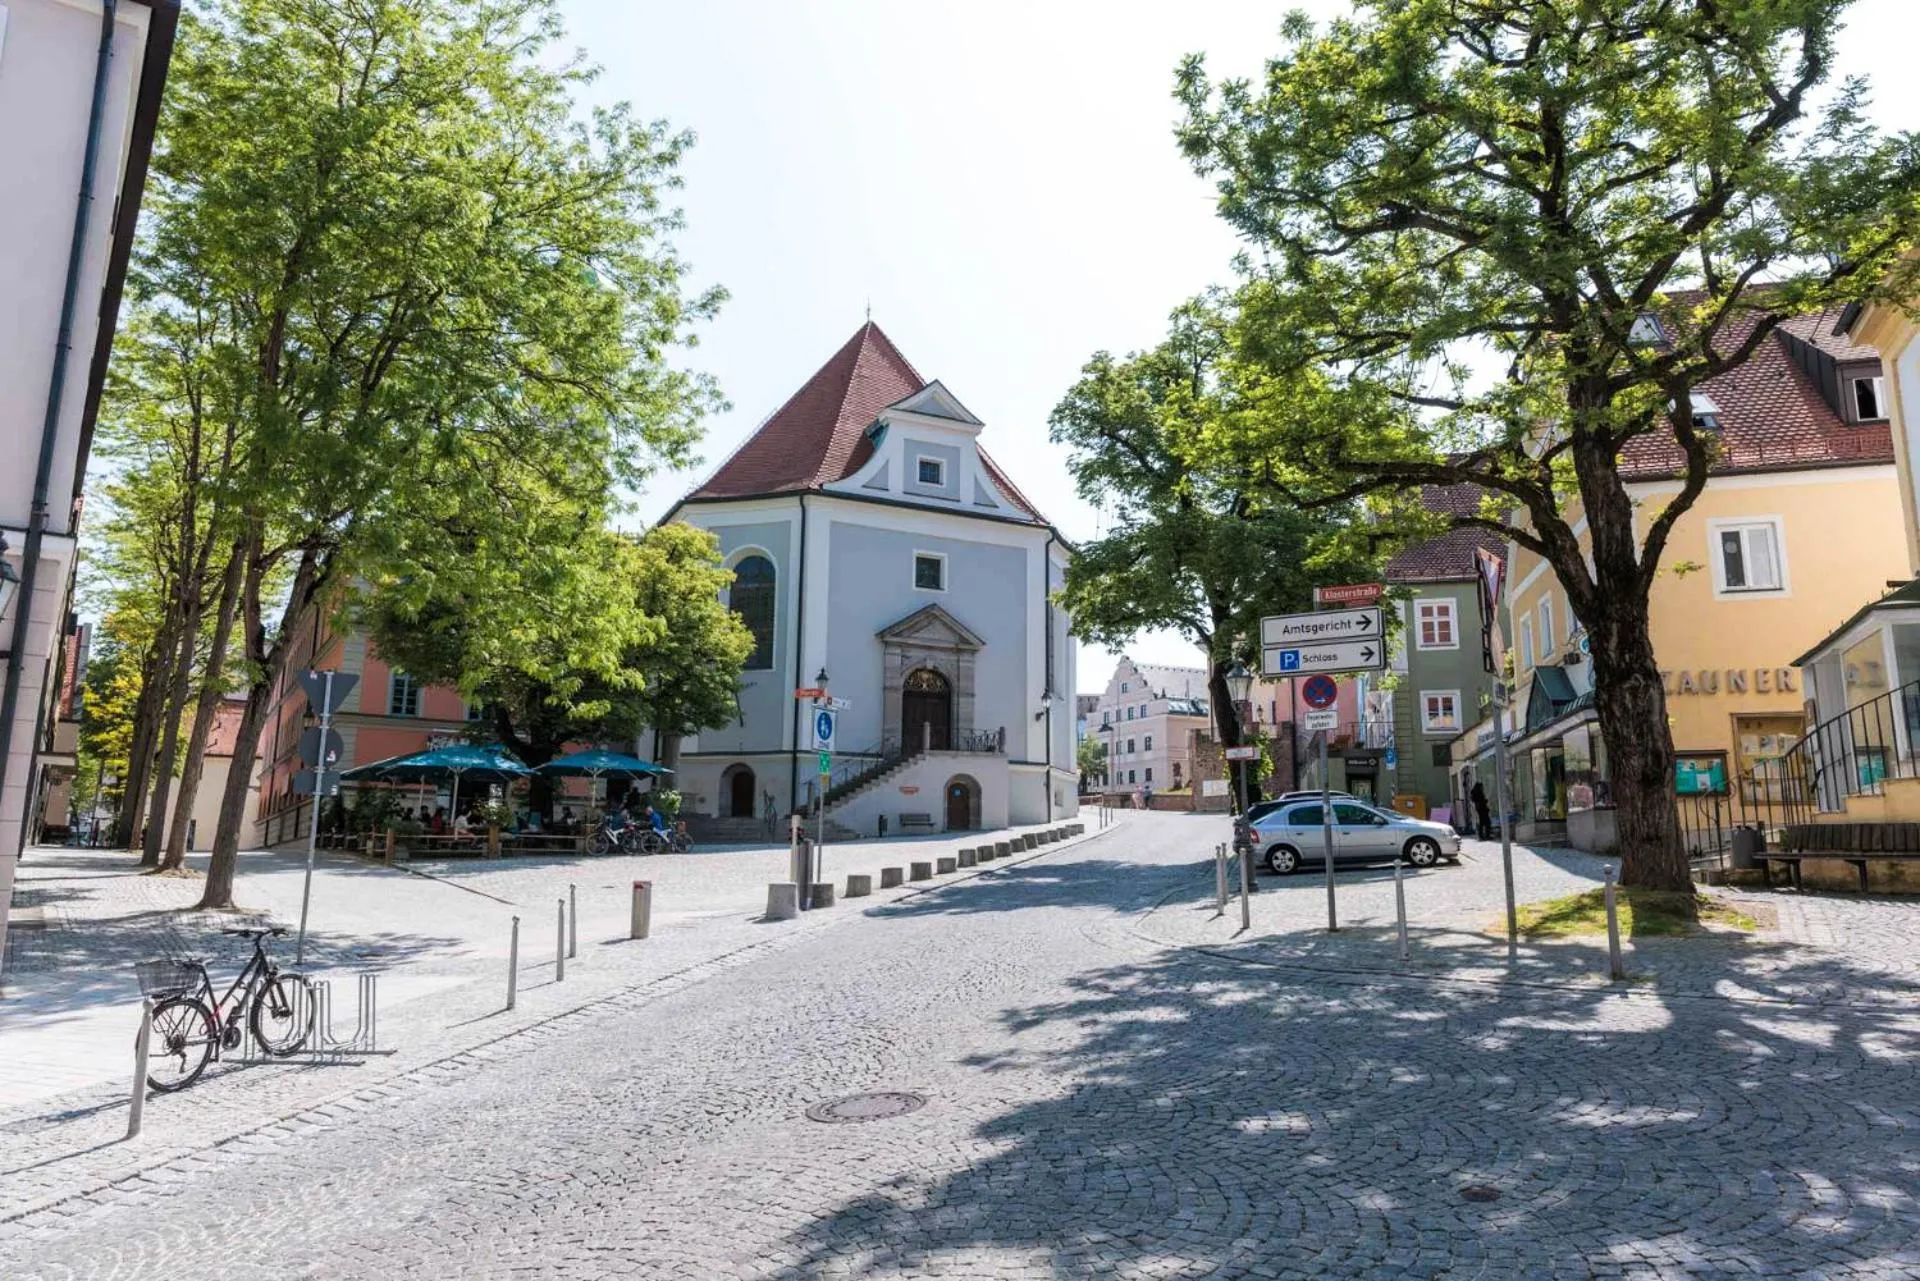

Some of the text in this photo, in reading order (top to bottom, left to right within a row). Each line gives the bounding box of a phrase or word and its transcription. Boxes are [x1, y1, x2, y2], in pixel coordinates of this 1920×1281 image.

[1324, 586, 1377, 600] Klosterstraße
[1282, 619, 1352, 636] Amtsgericht
[1302, 653, 1338, 664] Schloss
